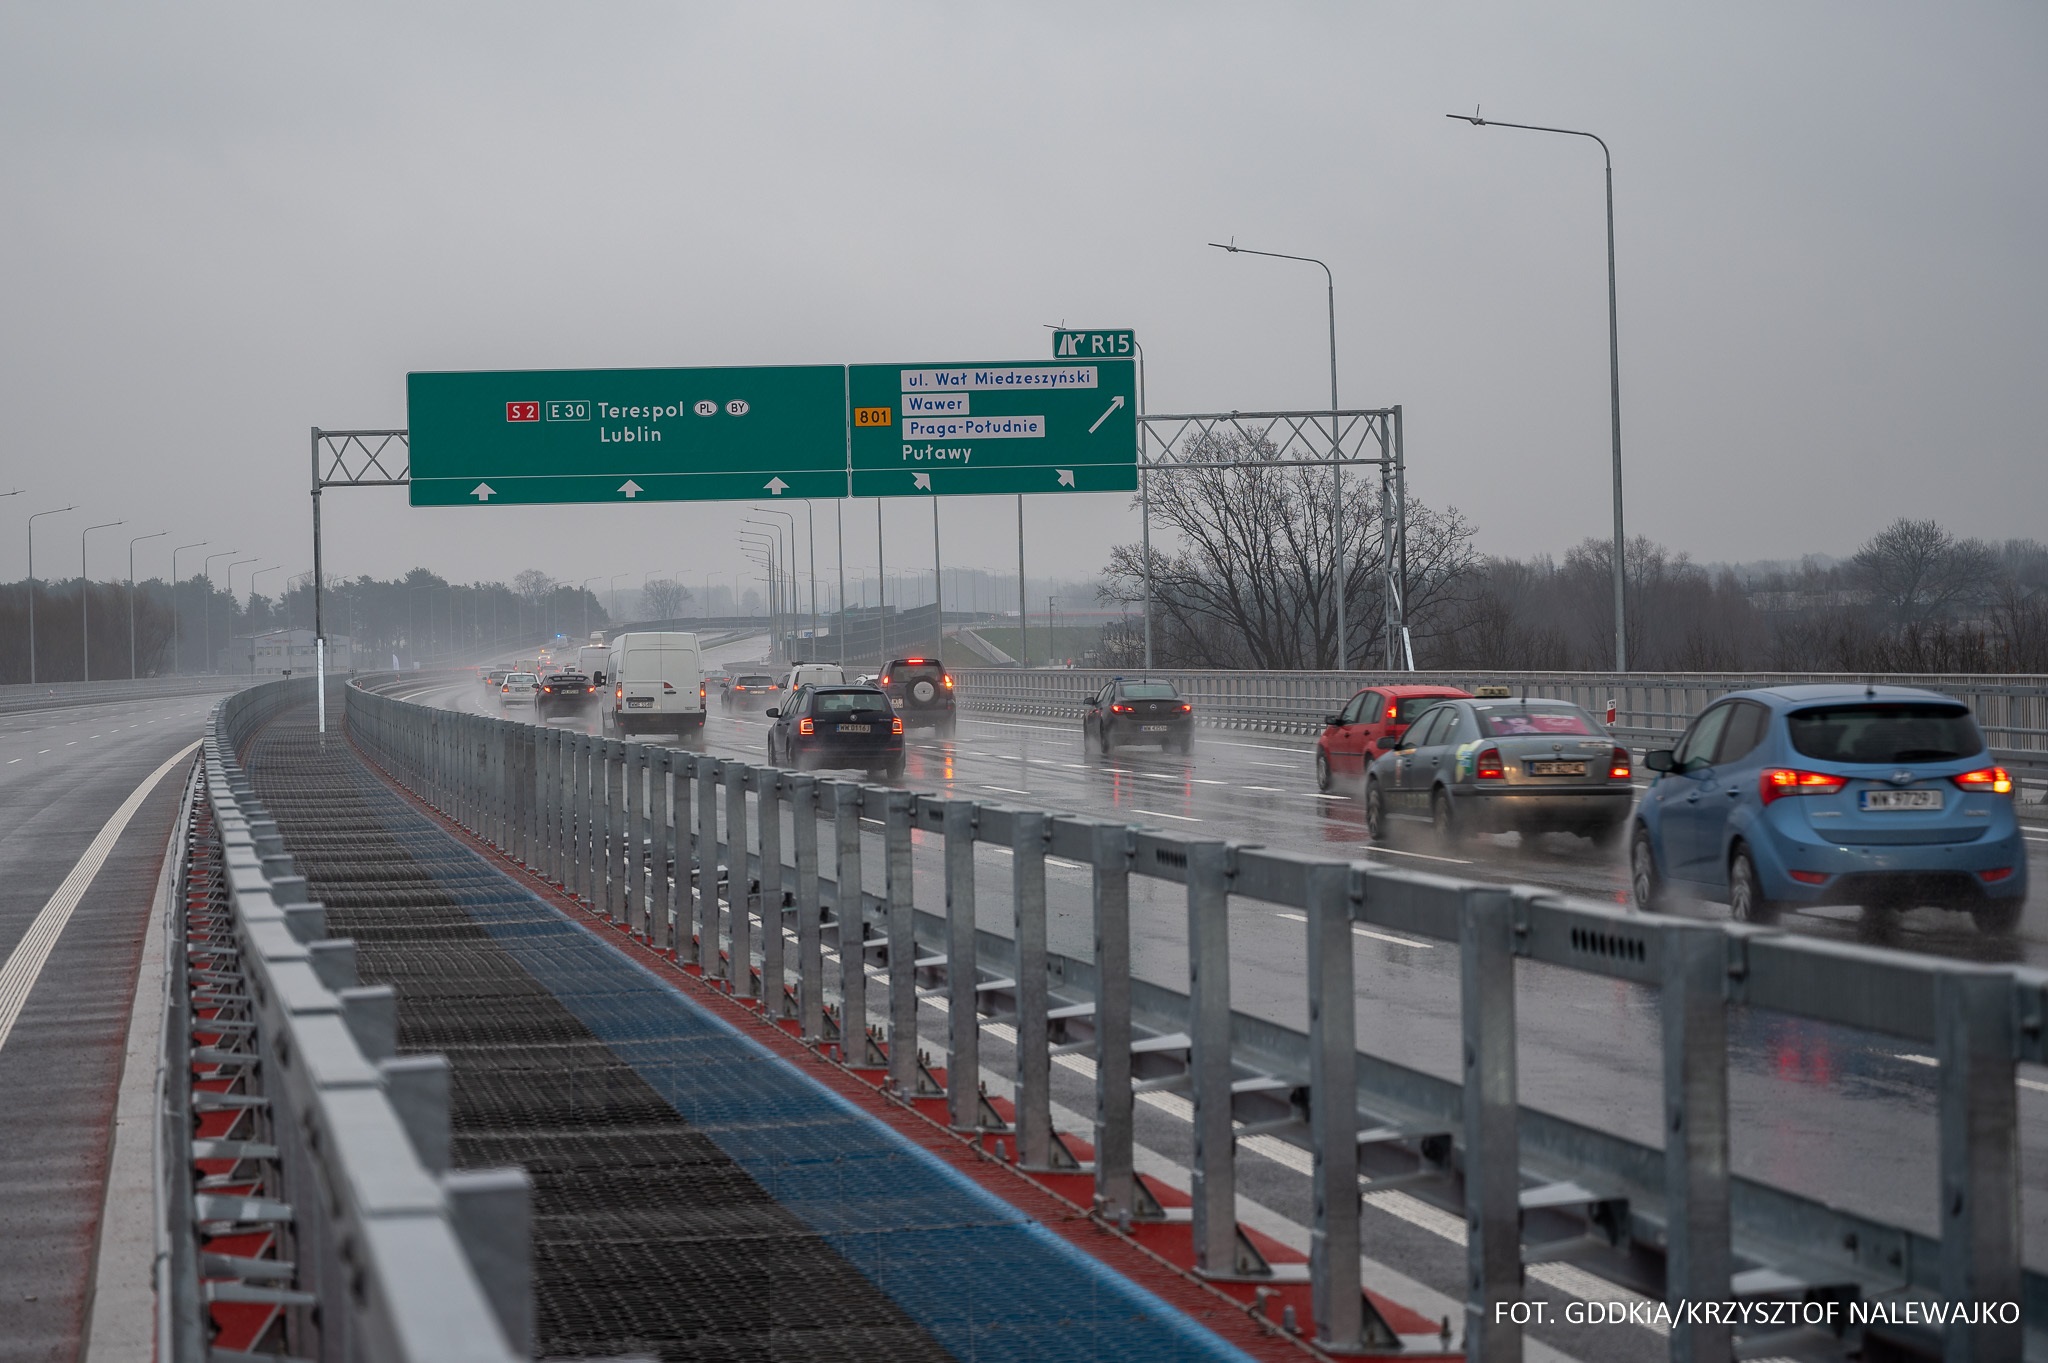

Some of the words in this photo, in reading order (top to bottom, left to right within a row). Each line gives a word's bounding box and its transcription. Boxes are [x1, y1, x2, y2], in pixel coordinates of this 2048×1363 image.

[1092, 334, 1130, 354] R15
[910, 373, 928, 387] ul.
[936, 372, 968, 386] Wał
[975, 369, 1090, 388] Miedzeszyński
[598, 401, 684, 422] Terespol
[699, 403, 712, 415] PL
[731, 402, 745, 414] BY
[909, 397, 962, 411] Wawer
[860, 411, 887, 424] 801
[601, 425, 661, 443] Lublin
[911, 419, 1038, 438] Praga-Południe
[903, 445, 972, 464] Puławy
[1481, 688, 1507, 696] TAXI
